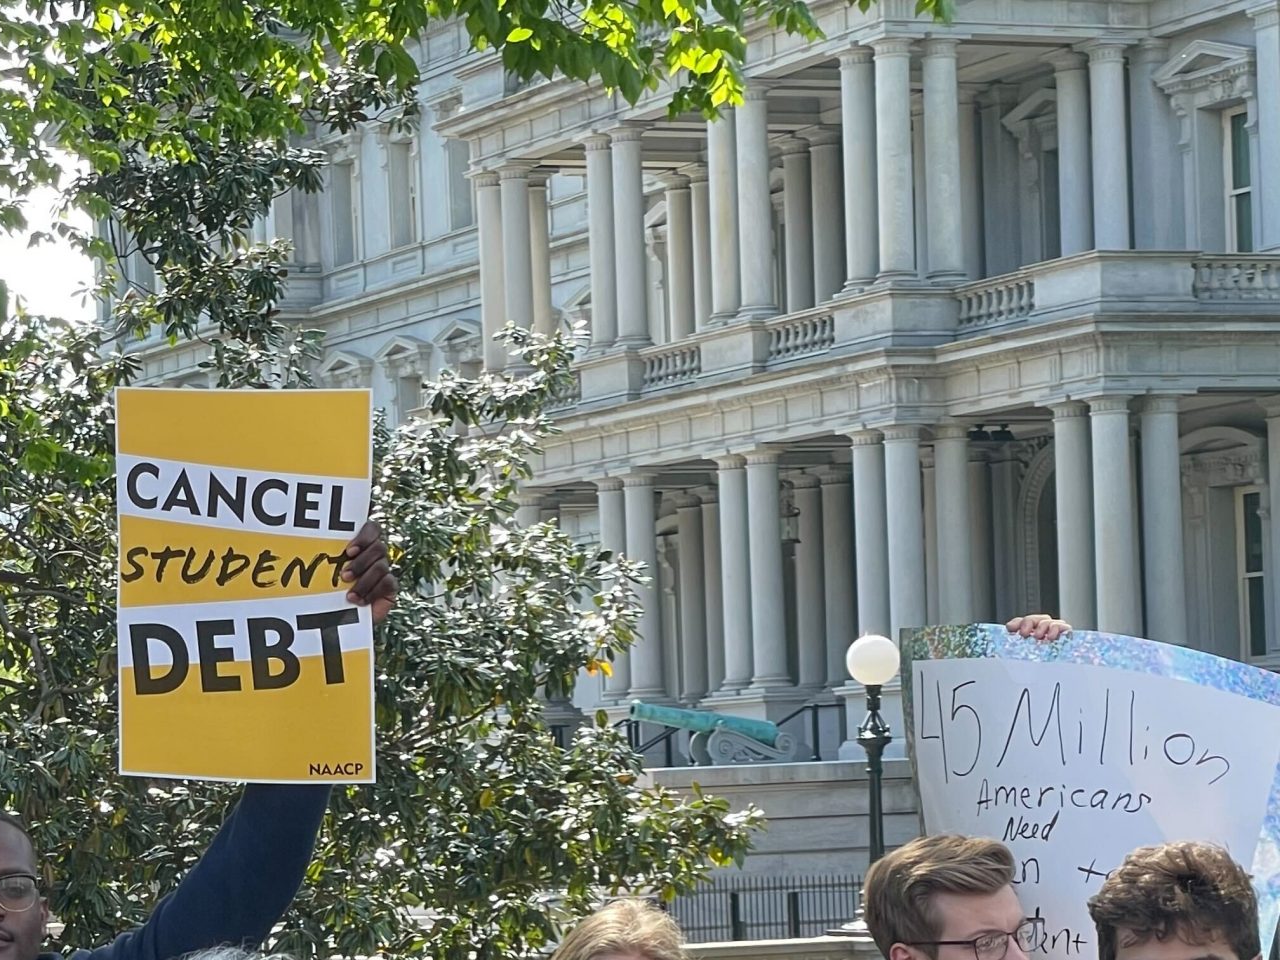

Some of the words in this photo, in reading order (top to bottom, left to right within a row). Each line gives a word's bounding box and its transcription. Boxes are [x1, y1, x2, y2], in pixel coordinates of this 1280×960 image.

[126, 462, 356, 532] CANCEL
[120, 545, 350, 589] STUDENT
[129, 607, 360, 696] DEBT
[919, 669, 982, 784] 45
[996, 681, 1231, 785] Million
[309, 762, 363, 776] NAACP
[976, 778, 1152, 817] Americans
[1002, 810, 1060, 842] Need
